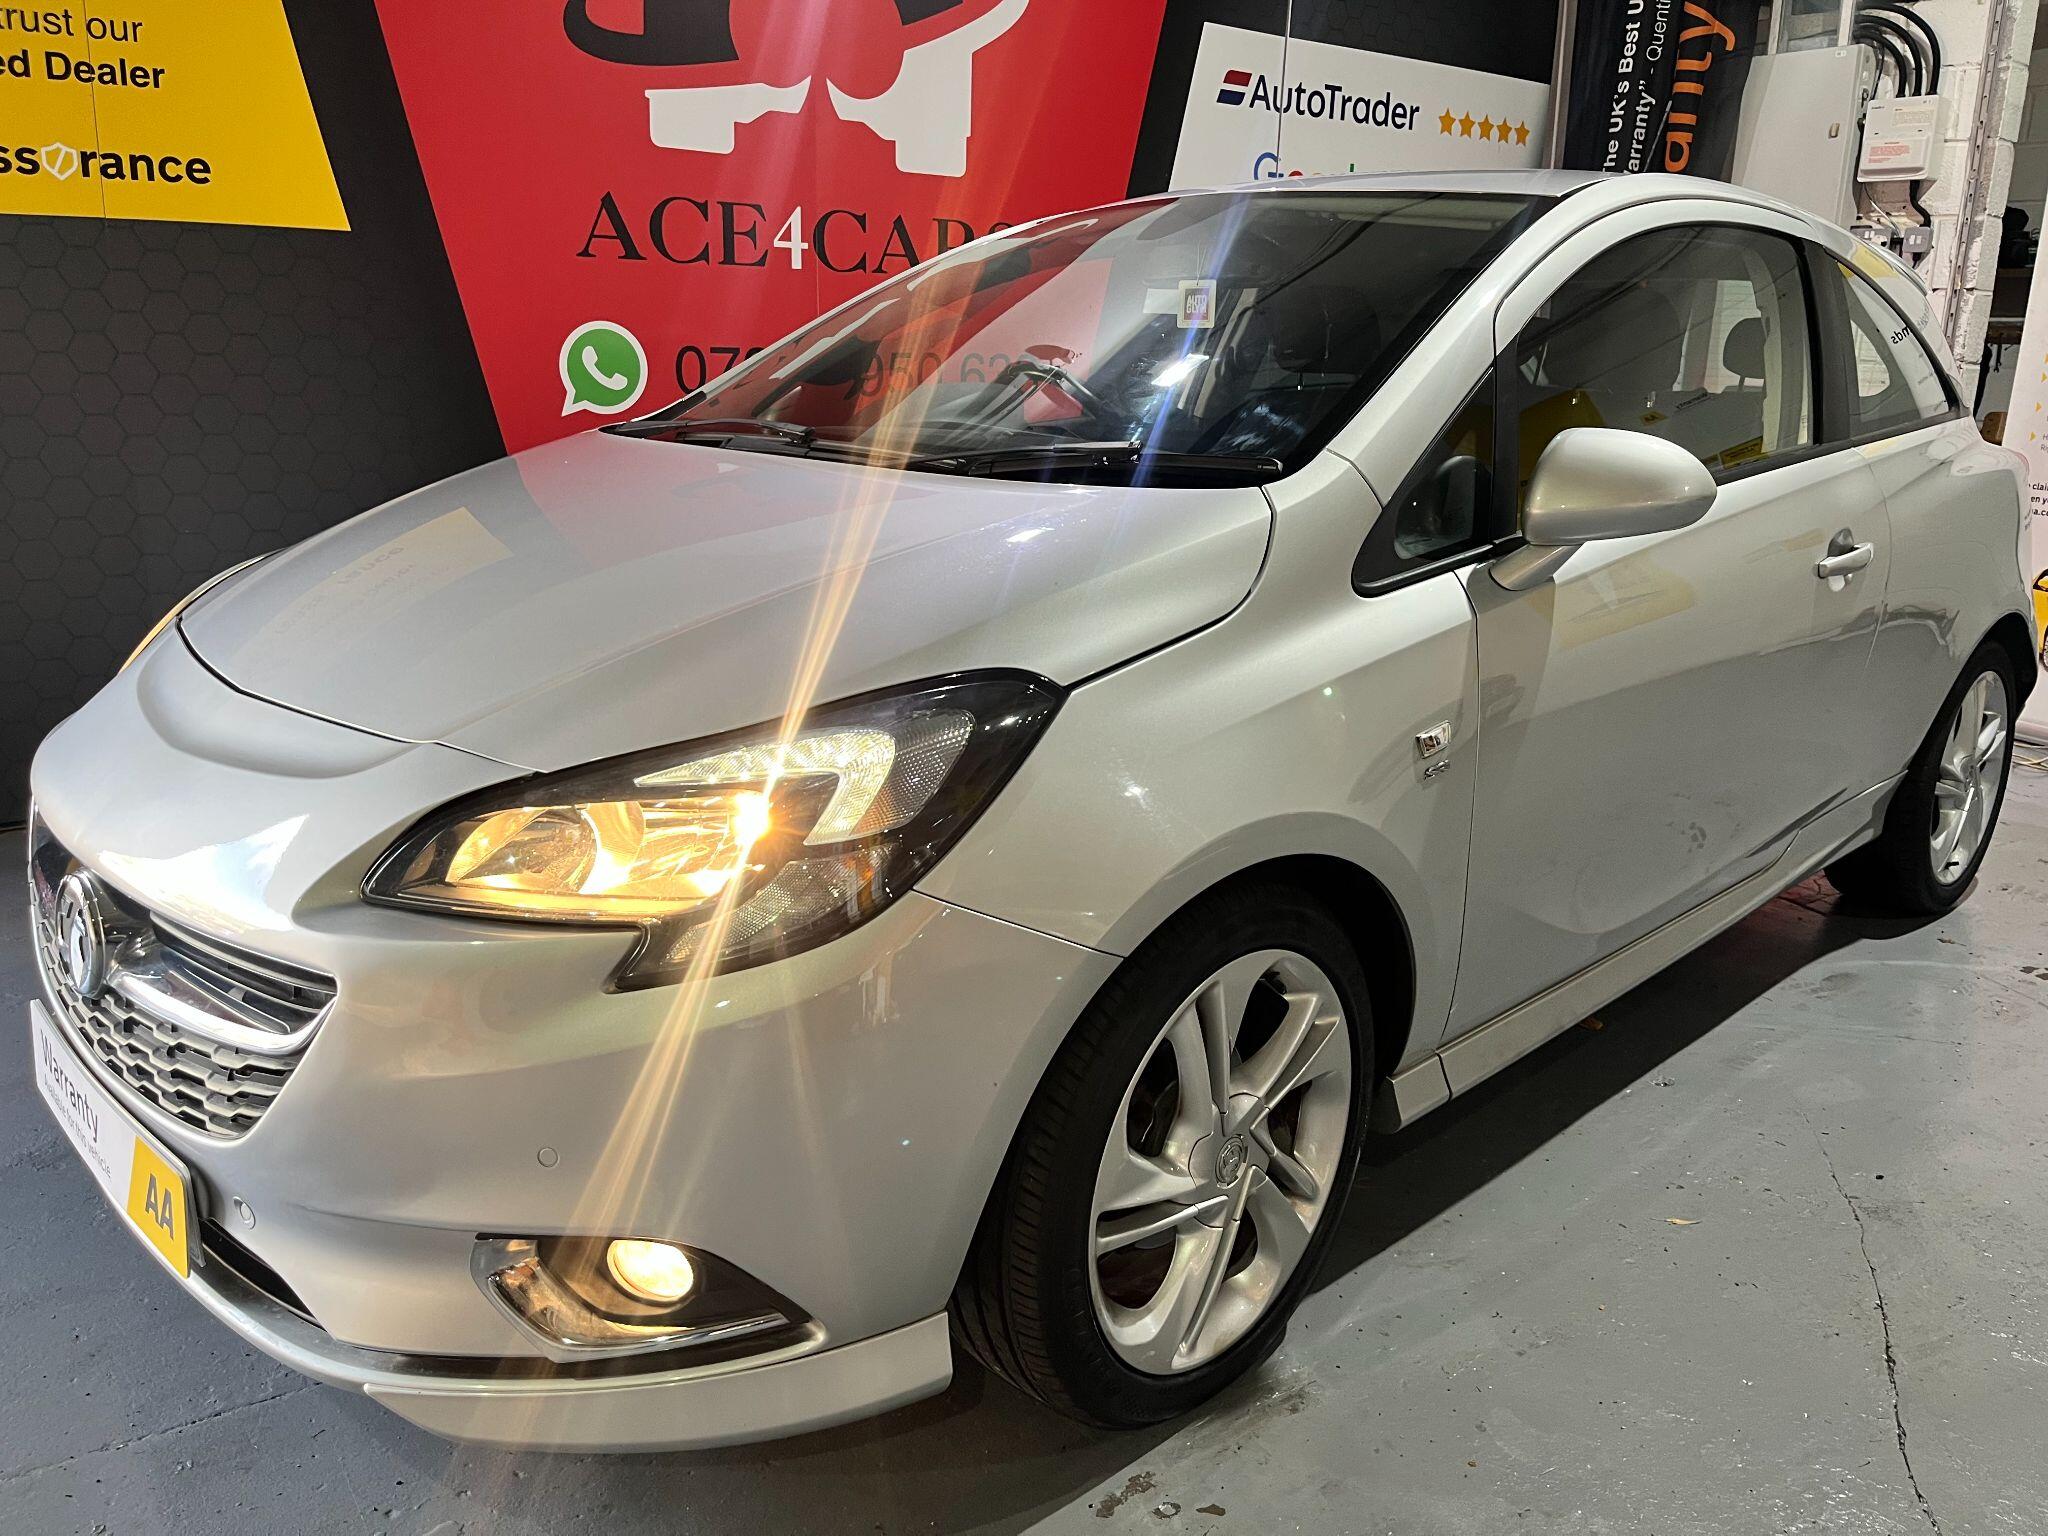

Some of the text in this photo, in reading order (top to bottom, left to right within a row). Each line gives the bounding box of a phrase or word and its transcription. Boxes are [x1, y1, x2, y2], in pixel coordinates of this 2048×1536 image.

[86, 17, 143, 42] our
[1618, 21, 1641, 73] Best
[0, 49, 165, 88] d Dealer
[1249, 75, 1420, 130] AutoTrader
[1624, 80, 1656, 173] arranty”
[576, 191, 1014, 274] ACE4CAR
[676, 345, 766, 395] 07
[40, 1029, 98, 1143] Warranty
[145, 1173, 174, 1241] AA
